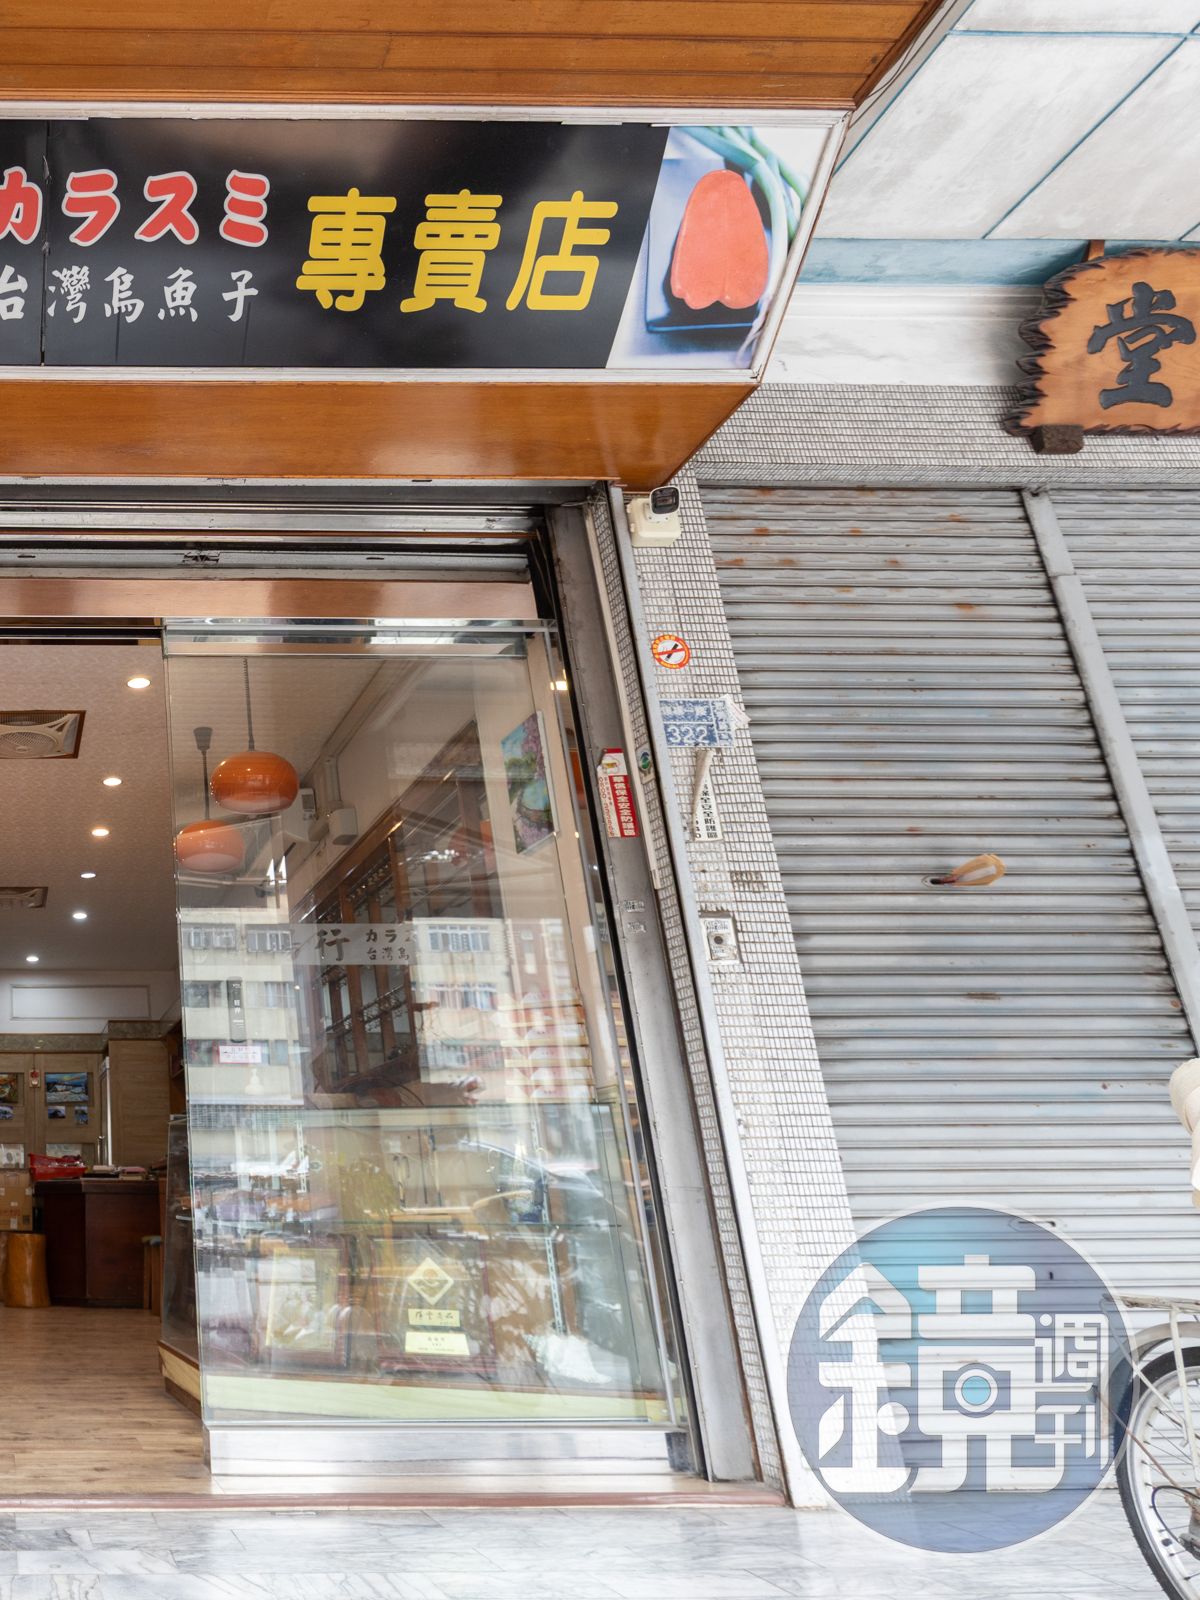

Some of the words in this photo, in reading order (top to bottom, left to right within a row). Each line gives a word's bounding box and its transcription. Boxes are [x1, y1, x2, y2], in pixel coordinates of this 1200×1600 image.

[296, 188, 619, 313] 專賣店
[1087, 281, 1197, 410] 堂
[667, 726, 708, 743] 322
